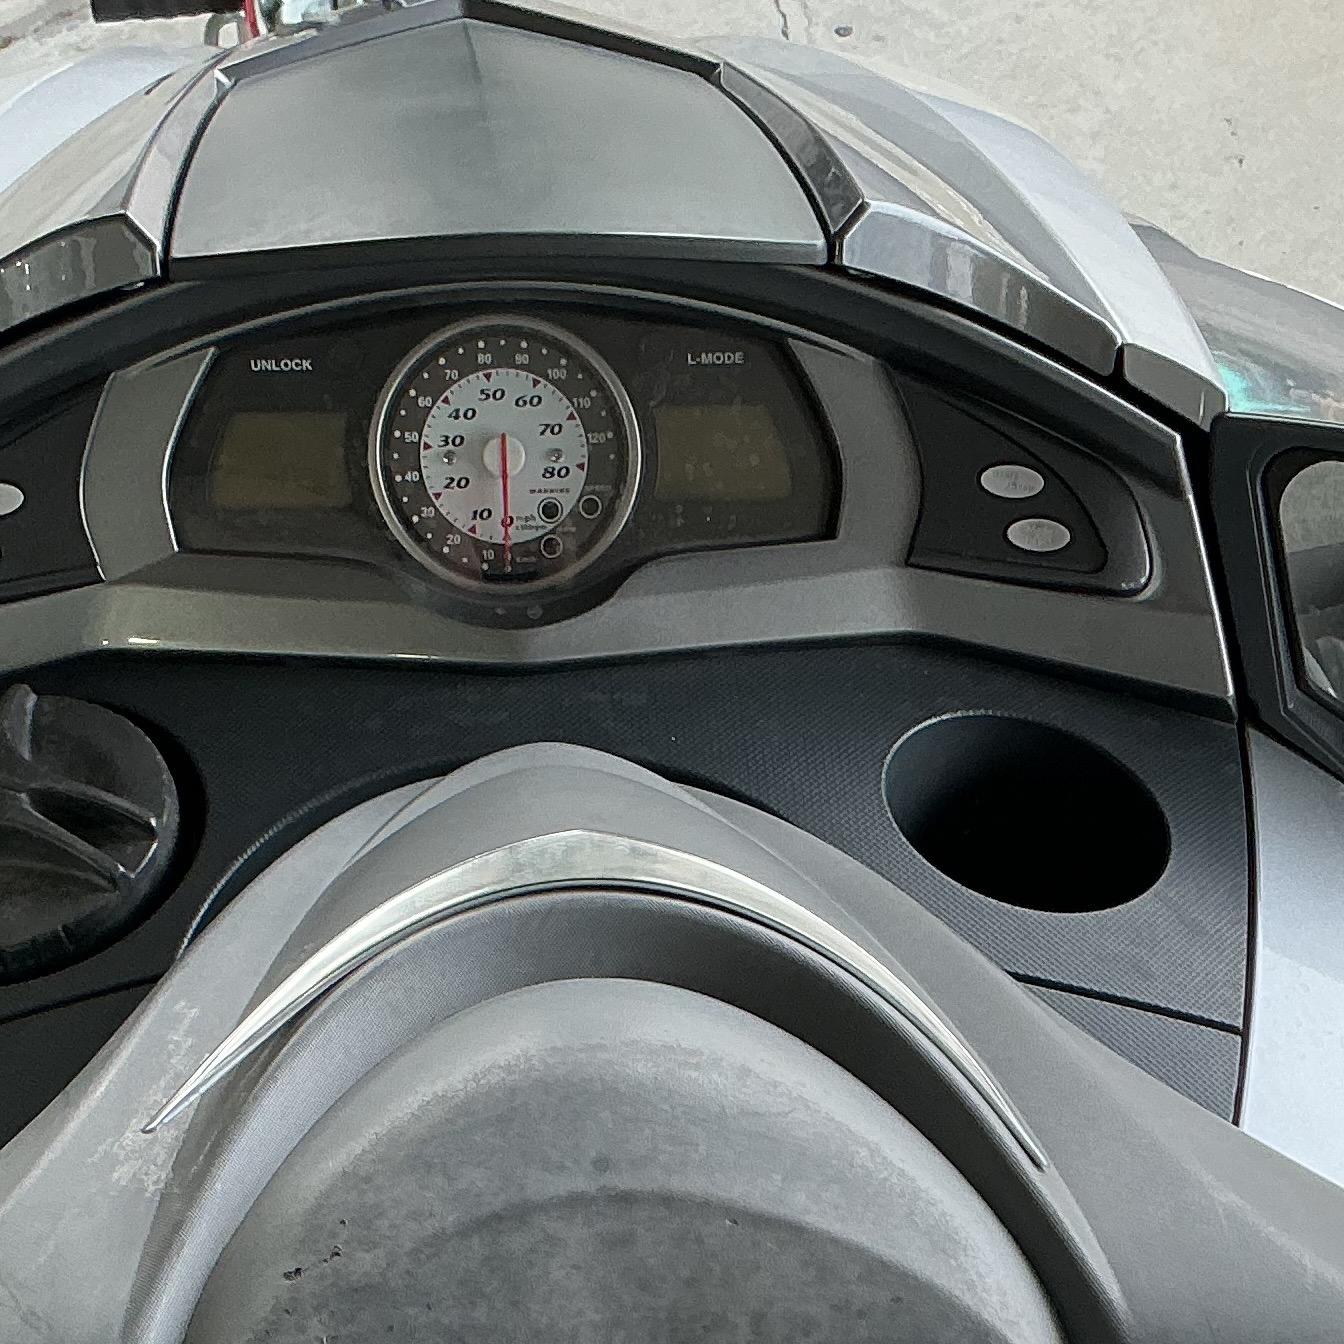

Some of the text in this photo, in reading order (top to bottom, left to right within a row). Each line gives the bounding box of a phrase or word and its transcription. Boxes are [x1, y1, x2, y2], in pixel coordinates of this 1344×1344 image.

[687, 351, 745, 365] L-MODE
[250, 359, 313, 371] UNLOCK
[444, 369, 459, 381] 70
[546, 368, 567, 380] 100
[476, 388, 506, 402] 50
[514, 394, 543, 408] 60
[417, 396, 433, 408] 60
[573, 397, 592, 409] 110
[447, 407, 477, 421] 40
[539, 423, 563, 436] 70
[404, 431, 419, 443] 50
[437, 434, 466, 448] 30
[587, 431, 607, 443] 120
[404, 470, 420, 482] 40
[542, 465, 571, 479] 80
[443, 476, 470, 490] 20
[471, 508, 493, 521] 10
[445, 533, 461, 545] 20
[482, 549, 495, 560] 10
